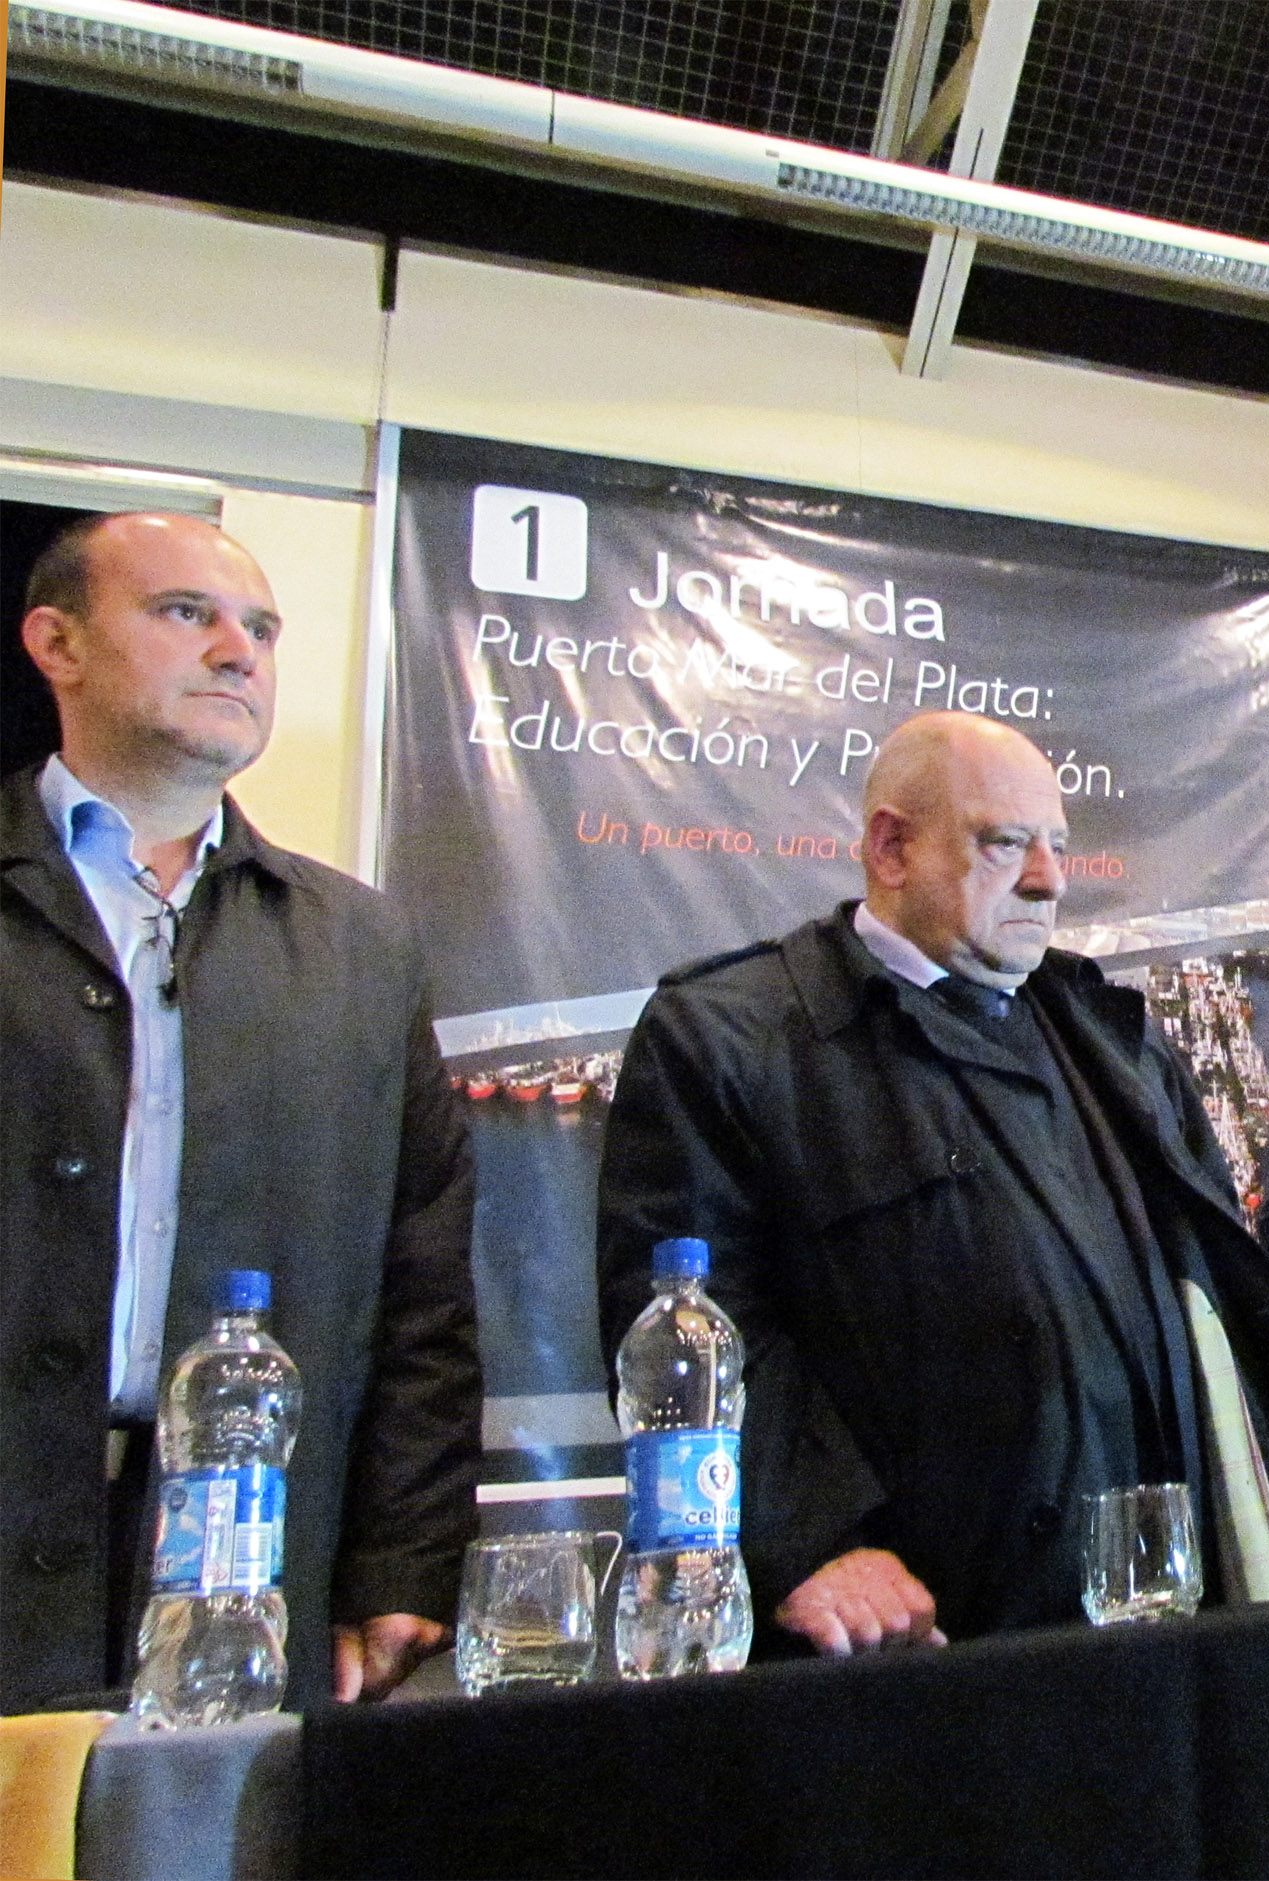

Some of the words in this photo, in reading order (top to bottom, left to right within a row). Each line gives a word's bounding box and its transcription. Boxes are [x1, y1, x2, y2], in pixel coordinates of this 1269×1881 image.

[511, 505, 540, 582] 1
[630, 551, 945, 642] Jornada
[472, 613, 660, 678] Puerto
[676, 637, 801, 692] Mar
[816, 654, 893, 703] del
[914, 661, 1053, 720] Plata:
[468, 694, 769, 769] Educación
[789, 738, 819, 787] y
[577, 811, 629, 845] Un
[640, 821, 760, 855] puerto,
[777, 835, 836, 859] una
[1062, 849, 1131, 879] ndo.
